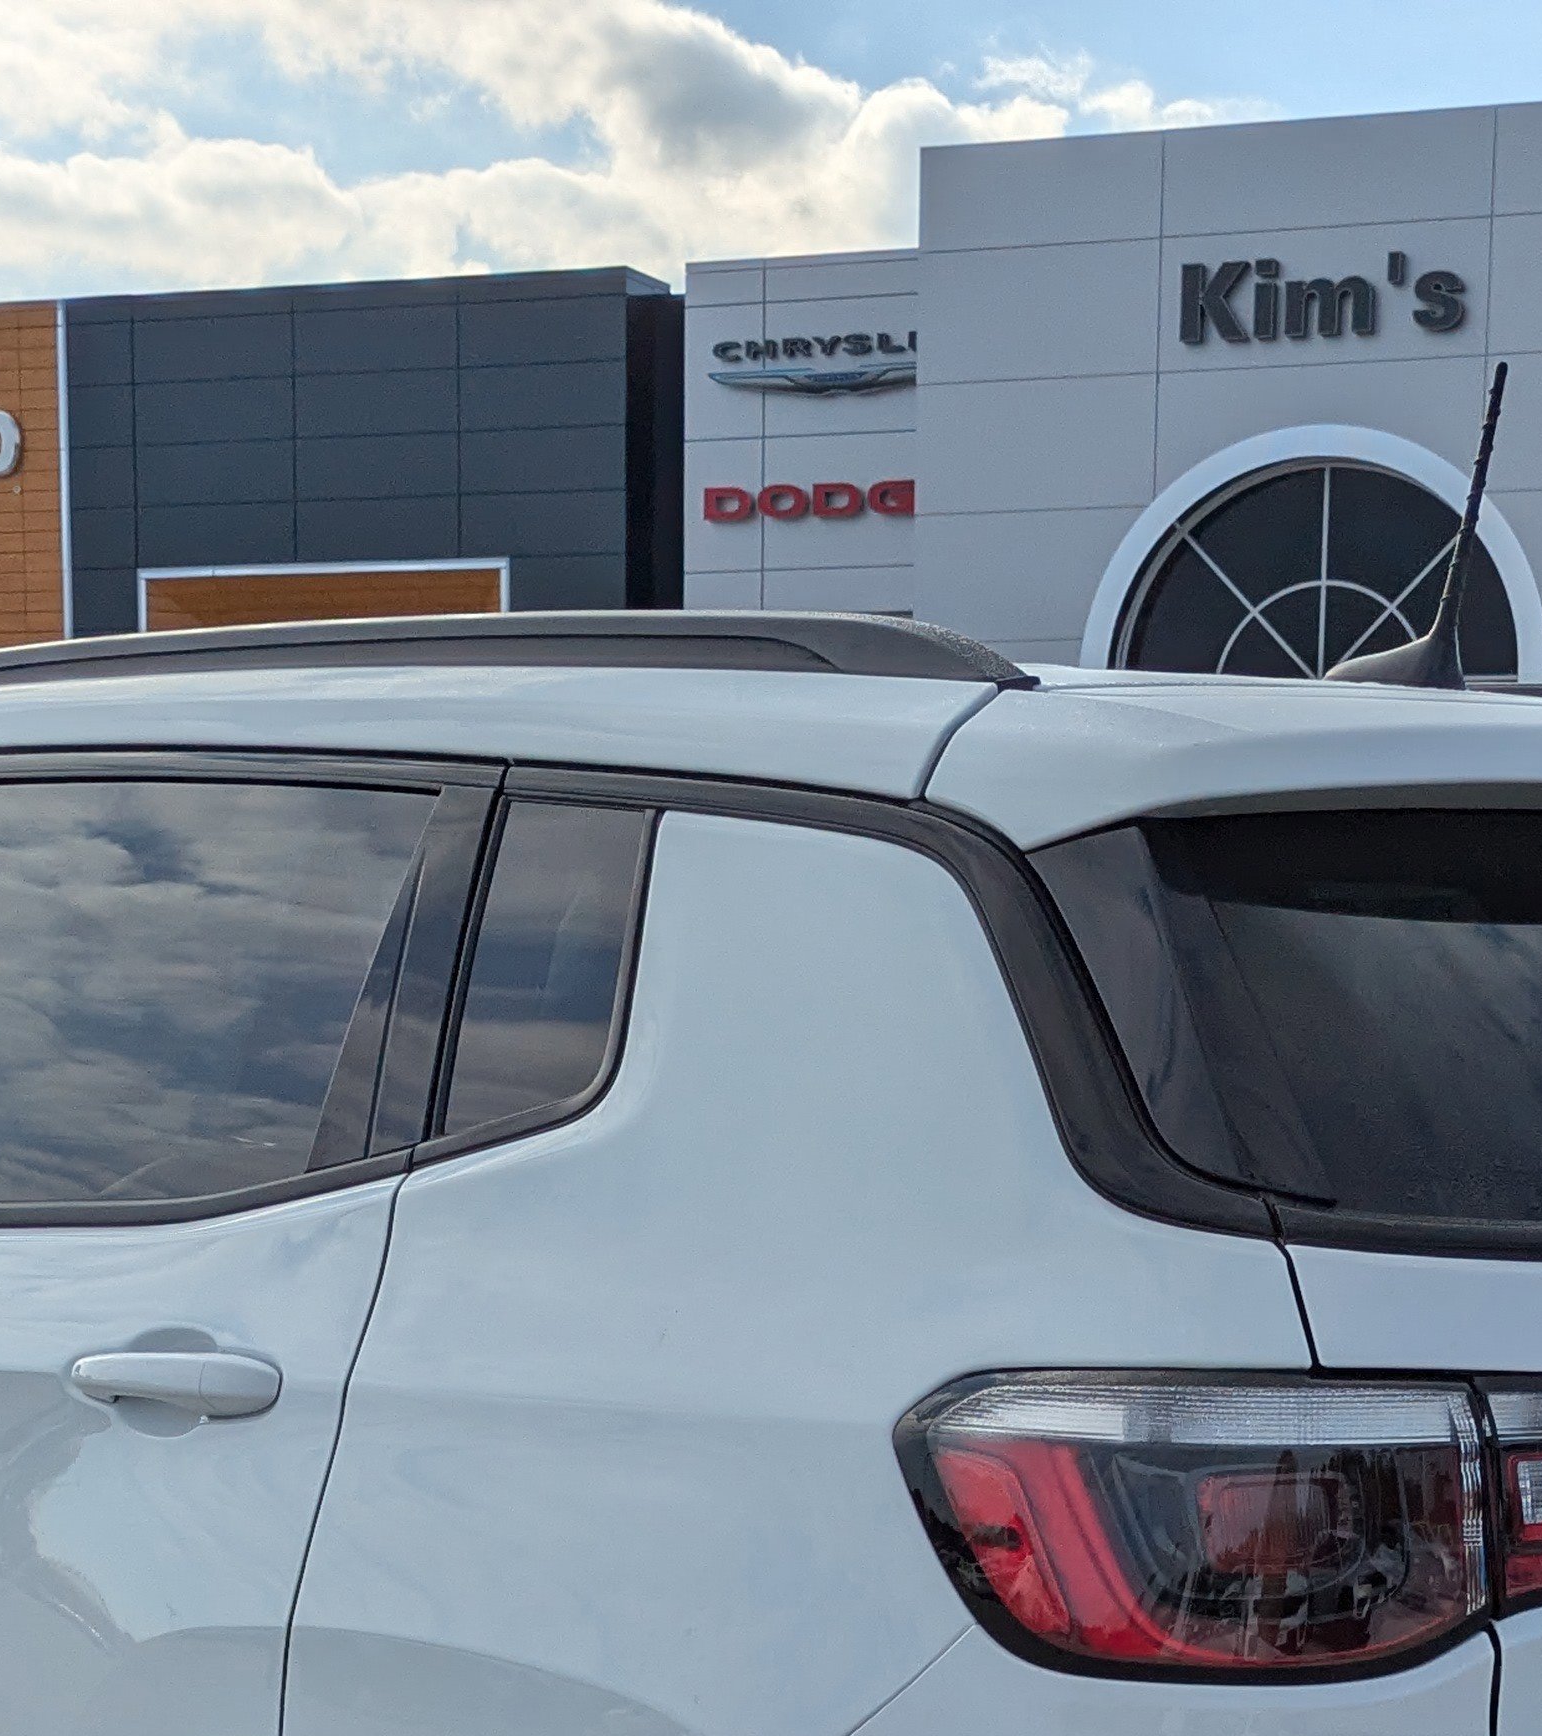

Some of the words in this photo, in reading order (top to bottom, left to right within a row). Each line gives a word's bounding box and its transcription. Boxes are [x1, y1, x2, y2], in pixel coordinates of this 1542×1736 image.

[1179, 251, 1468, 346] Kim's
[712, 331, 917, 362] CHRYSL
[704, 479, 915, 522] DODG
